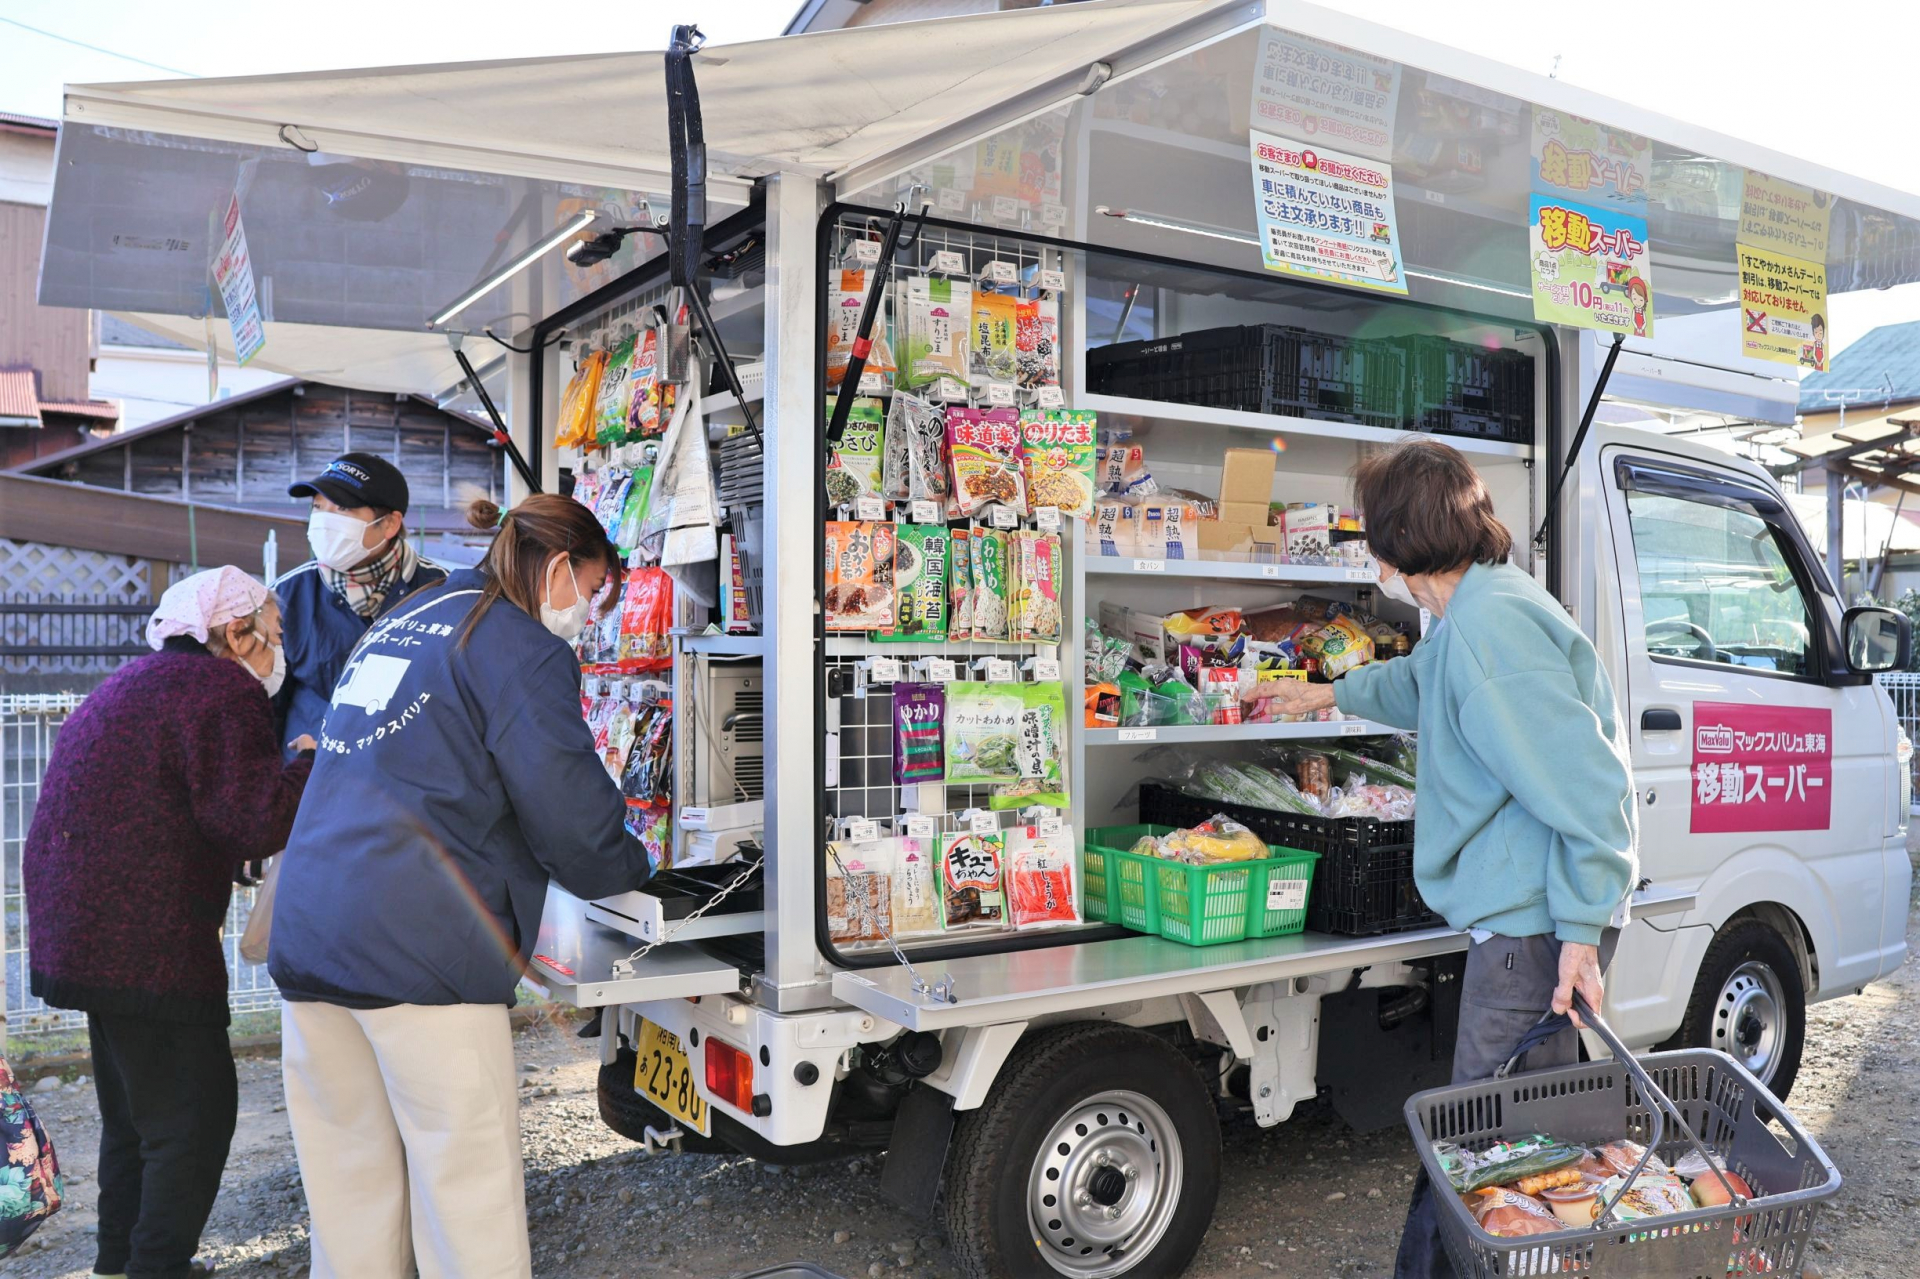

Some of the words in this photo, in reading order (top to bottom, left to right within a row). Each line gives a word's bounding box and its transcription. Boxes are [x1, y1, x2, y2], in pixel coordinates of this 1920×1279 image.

[1258, 145, 1300, 165] お客さまの
[1319, 161, 1388, 187] お聞かせください。
[1262, 179, 1385, 219] 車に積んでいない商品も
[1264, 200, 1365, 237] ご注文承ります!!
[1540, 206, 1642, 260] 移動スーパー
[1741, 254, 1823, 285] 「すこやかカメさんデー」の
[1743, 271, 1820, 300] 割引は、移動スーパーでは
[1743, 289, 1810, 314] 対応しておりません。
[841, 308, 852, 342] いりごま
[1594, 313, 1630, 327] いただきます
[932, 318, 943, 353] すりごま
[979, 322, 991, 357] 塩昆布
[956, 423, 1016, 446] 味道楽
[1024, 423, 1093, 445] のりたま
[1048, 454, 1066, 467] 65
[1108, 449, 1125, 481] 超熟
[1133, 450, 1139, 458] 5
[337, 463, 370, 481] SORYU
[1099, 507, 1116, 539] 超熟
[1124, 507, 1130, 516] 6
[1165, 508, 1181, 540] 超熟
[840, 552, 853, 580] 昆布
[848, 530, 869, 577] おかか
[984, 541, 998, 588] わかめ
[1140, 562, 1159, 570] 食パン
[1037, 556, 1049, 581] 鮭
[915, 581, 924, 618] ふりかけ
[356, 692, 431, 750] マックスバリュ
[900, 703, 940, 722] ゆかり
[955, 713, 1015, 726] カットわかめ
[1022, 711, 1043, 774] 味噌汁の具
[1125, 731, 1151, 740] フルーツ
[1701, 732, 1729, 747] MaxValu
[1735, 732, 1826, 754] マックスバリュ東海
[1697, 763, 1823, 805] 移動スーパー
[949, 846, 992, 869] キュー
[955, 868, 996, 879] ちゃん
[1037, 858, 1055, 910] 紅しょうが
[657, 1026, 677, 1050] 湘南
[640, 1055, 648, 1076] あ
